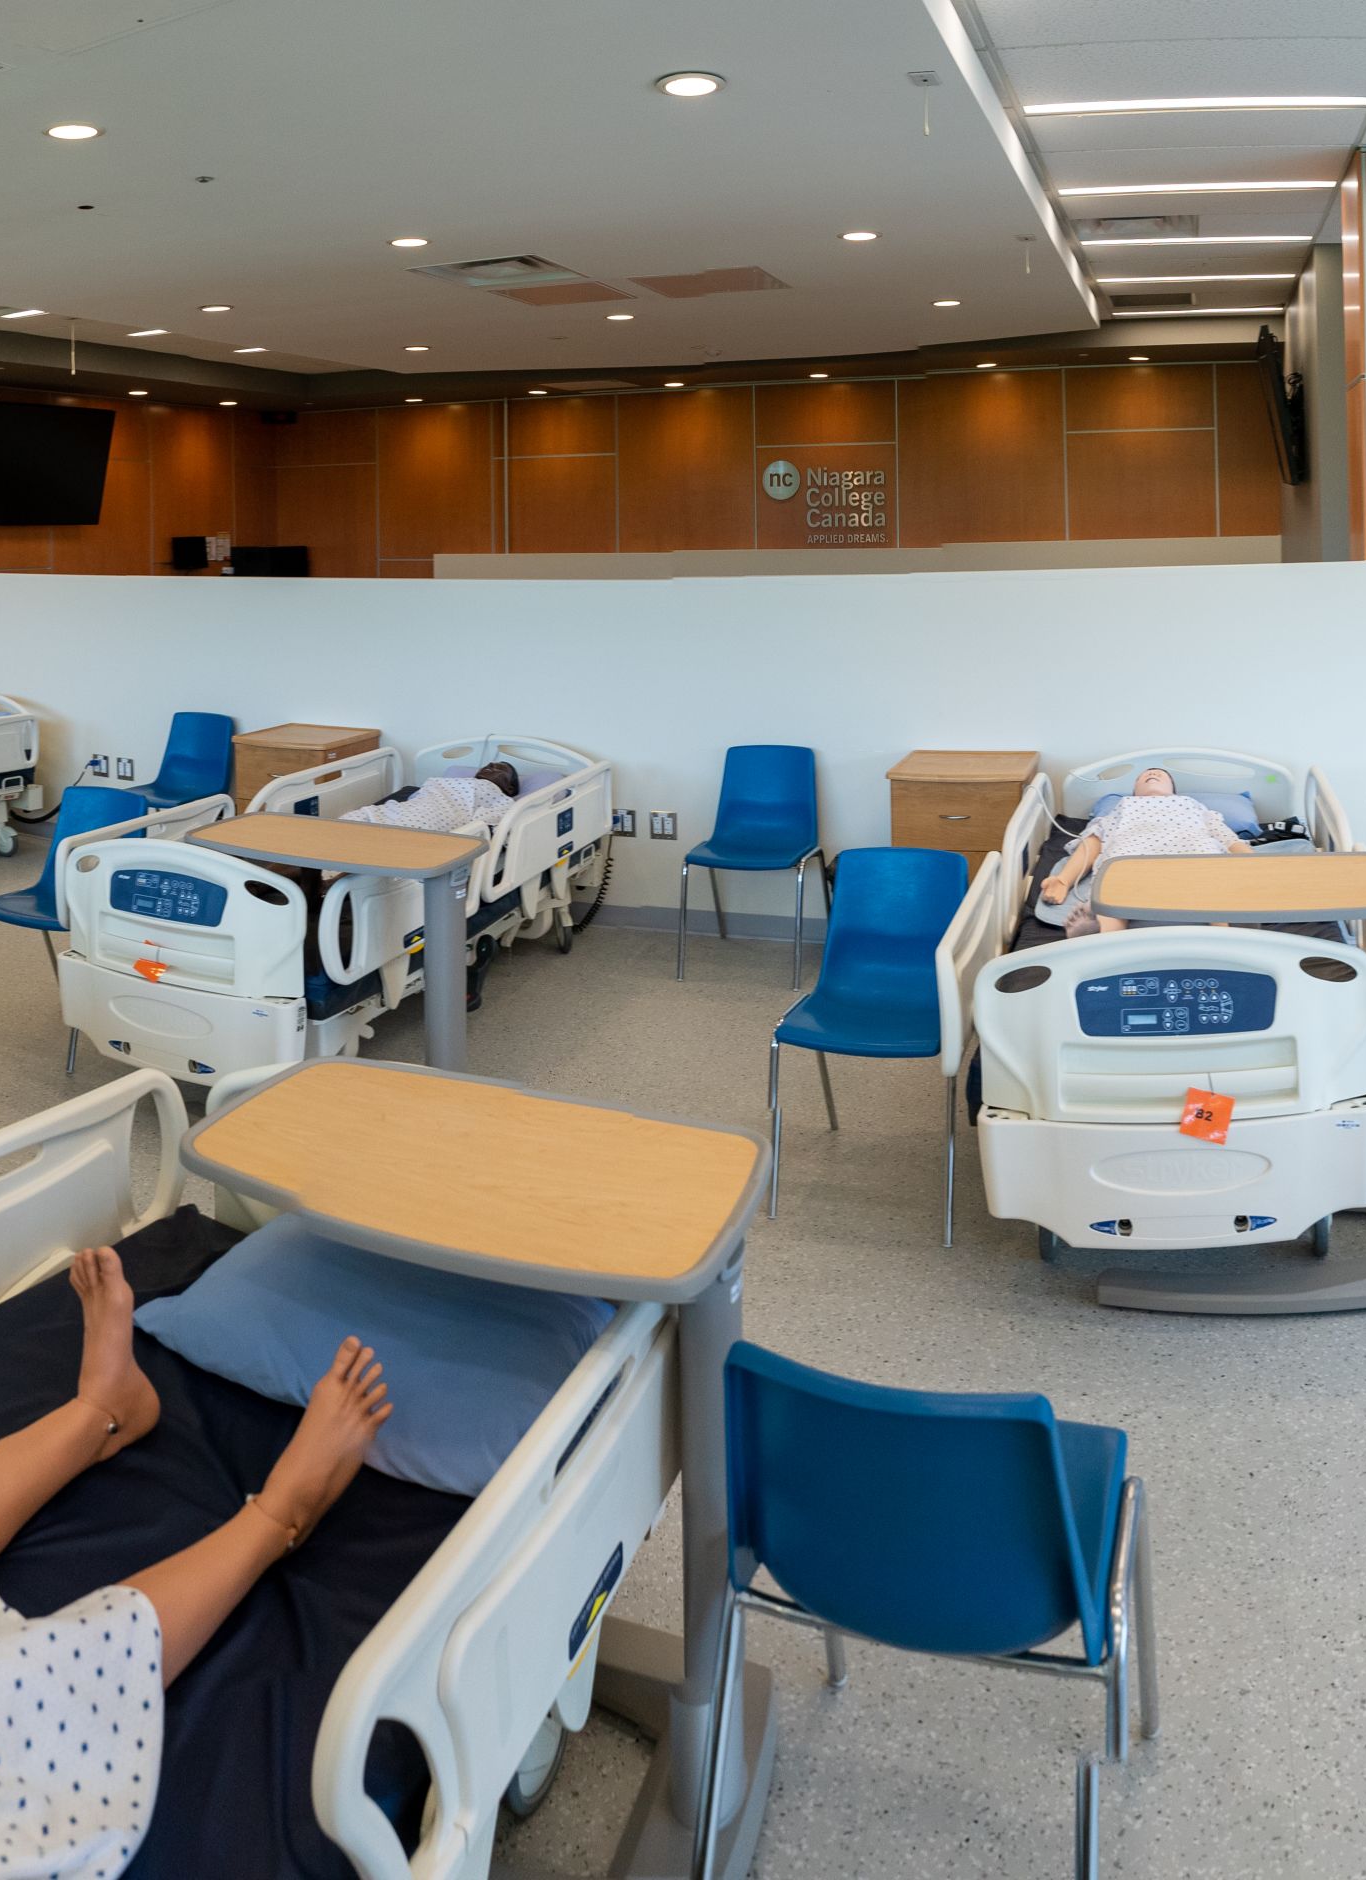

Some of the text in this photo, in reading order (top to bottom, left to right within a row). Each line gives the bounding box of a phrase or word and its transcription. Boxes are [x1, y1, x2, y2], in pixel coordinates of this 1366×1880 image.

[769, 472, 793, 487] nc
[806, 467, 885, 489] Niagara
[806, 487, 885, 511] College
[806, 508, 886, 528] Canada
[807, 534, 844, 544] APPLIED
